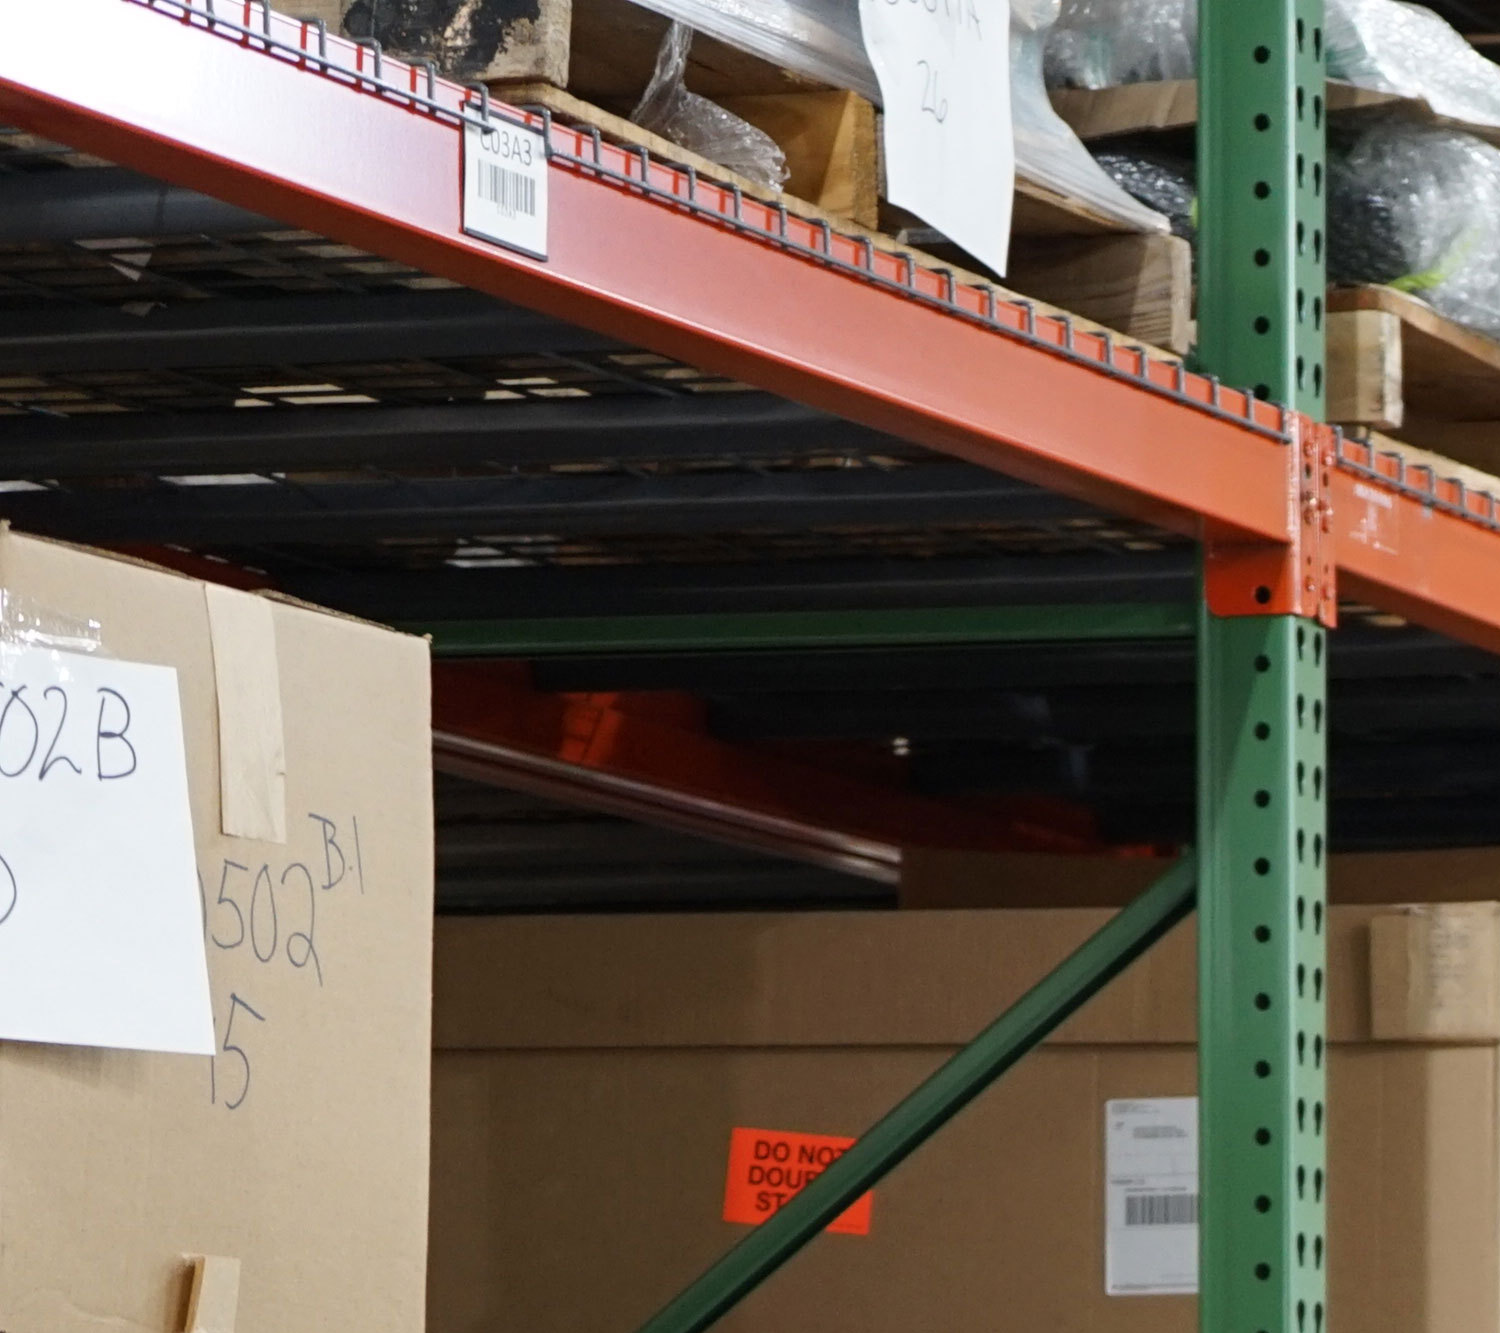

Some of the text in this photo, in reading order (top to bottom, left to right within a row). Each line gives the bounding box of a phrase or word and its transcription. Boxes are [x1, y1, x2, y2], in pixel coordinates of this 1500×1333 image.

[0, 679, 137, 780] 02B
[753, 1139, 848, 1167] DO NO
